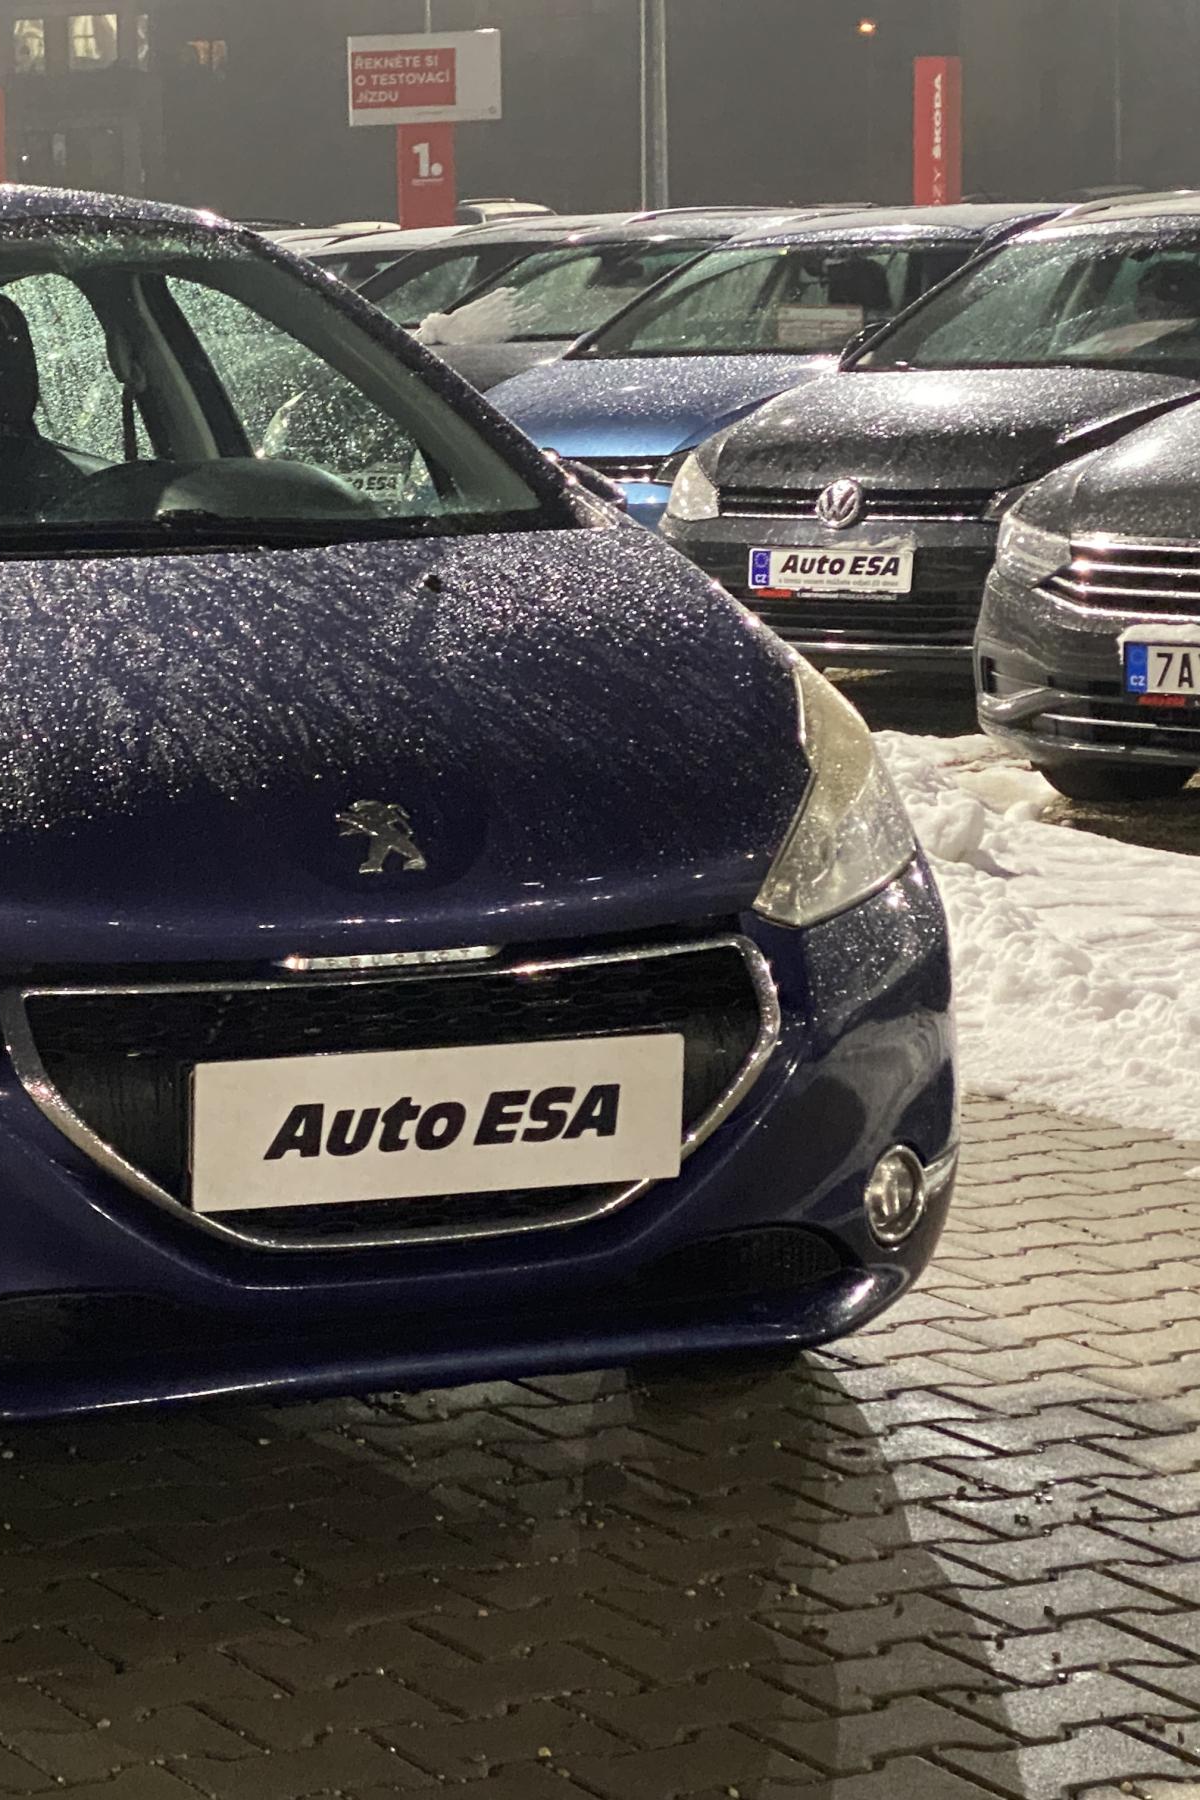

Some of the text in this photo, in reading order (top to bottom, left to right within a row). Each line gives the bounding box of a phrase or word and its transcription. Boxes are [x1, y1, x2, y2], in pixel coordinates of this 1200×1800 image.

[353, 55, 439, 70] ŘEKNĚTE SI
[355, 69, 450, 87] O TESTOVACÍ
[412, 142, 443, 177] 1.
[780, 554, 900, 576] Auto ESA
[755, 574, 767, 583] CZ
[1130, 675, 1146, 686] CZ
[1157, 653, 1200, 688] 7A
[263, 1083, 621, 1160] Auto ESA
